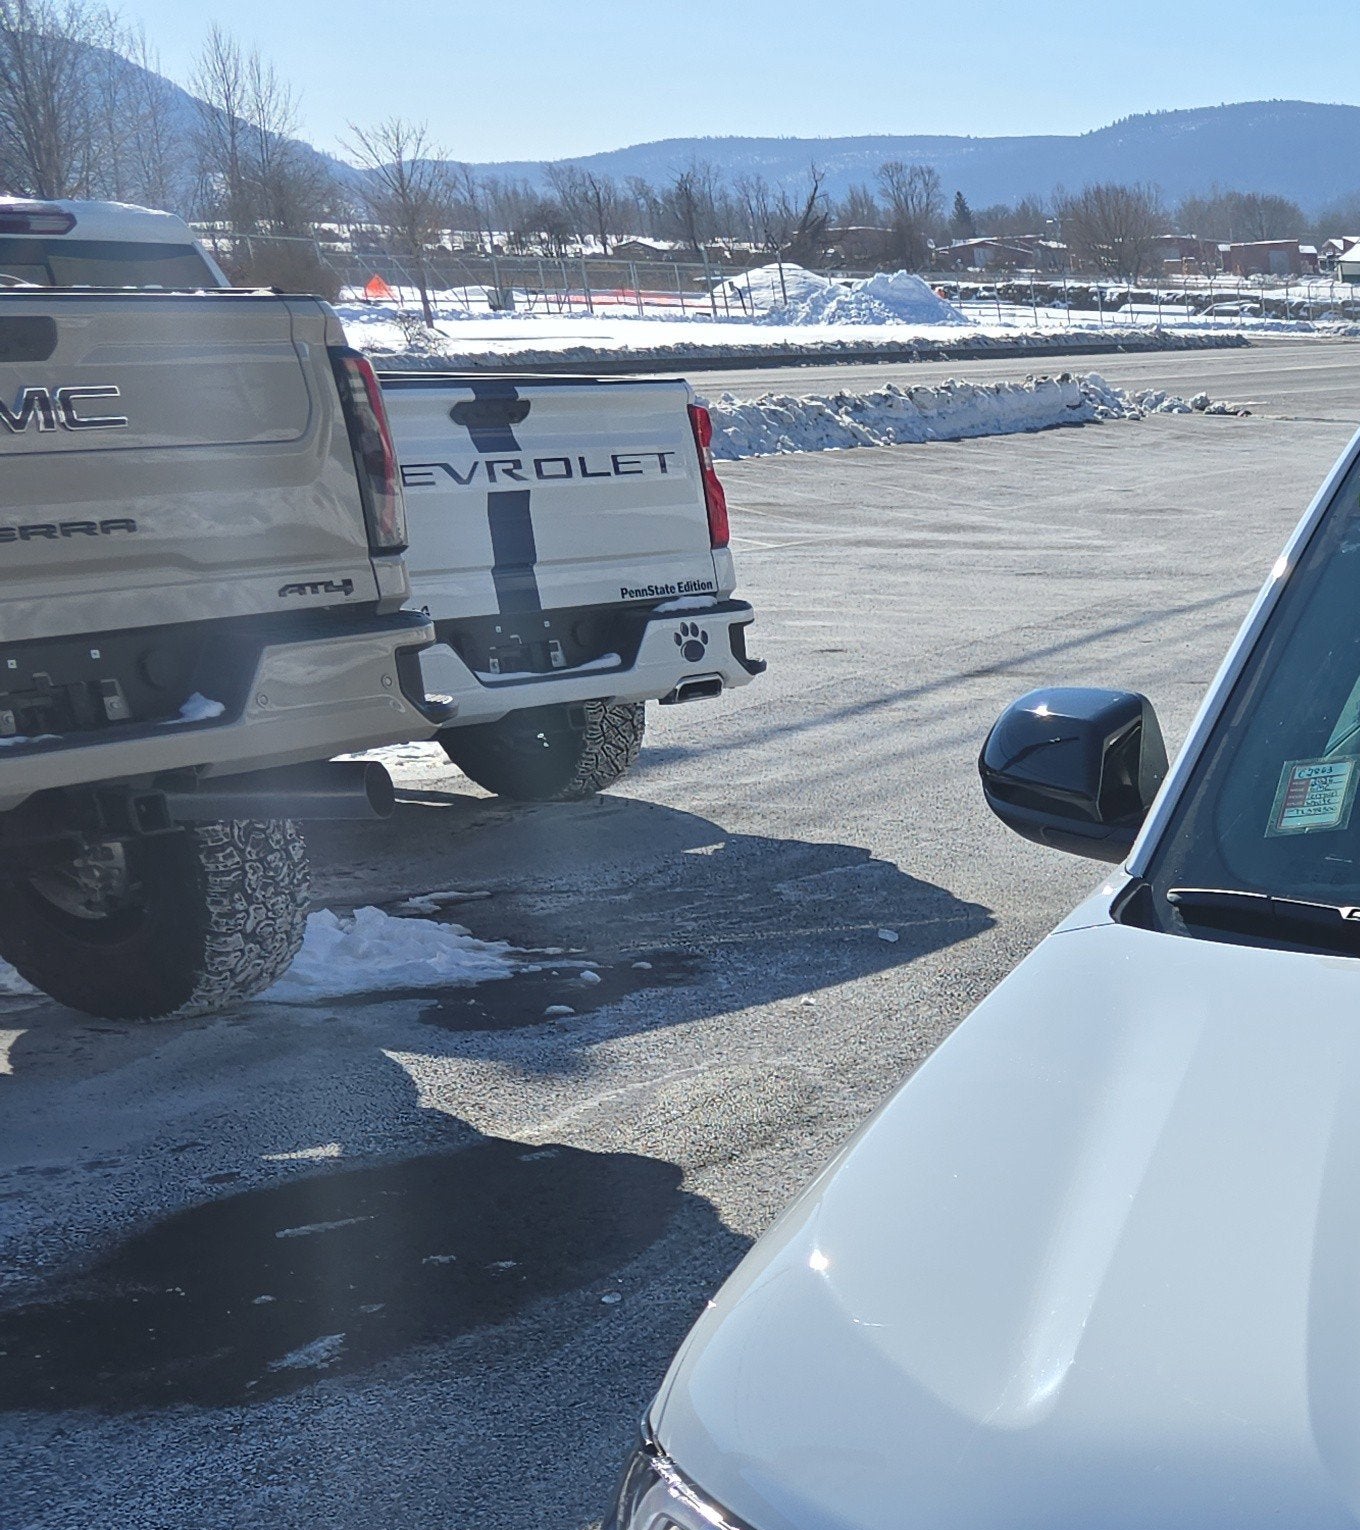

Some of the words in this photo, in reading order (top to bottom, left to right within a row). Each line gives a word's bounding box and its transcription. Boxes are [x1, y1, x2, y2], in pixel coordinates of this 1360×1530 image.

[400, 451, 676, 487] EVROLET
[278, 578, 355, 598] AT4
[620, 584, 676, 599] PennState
[677, 579, 714, 593] Edition
